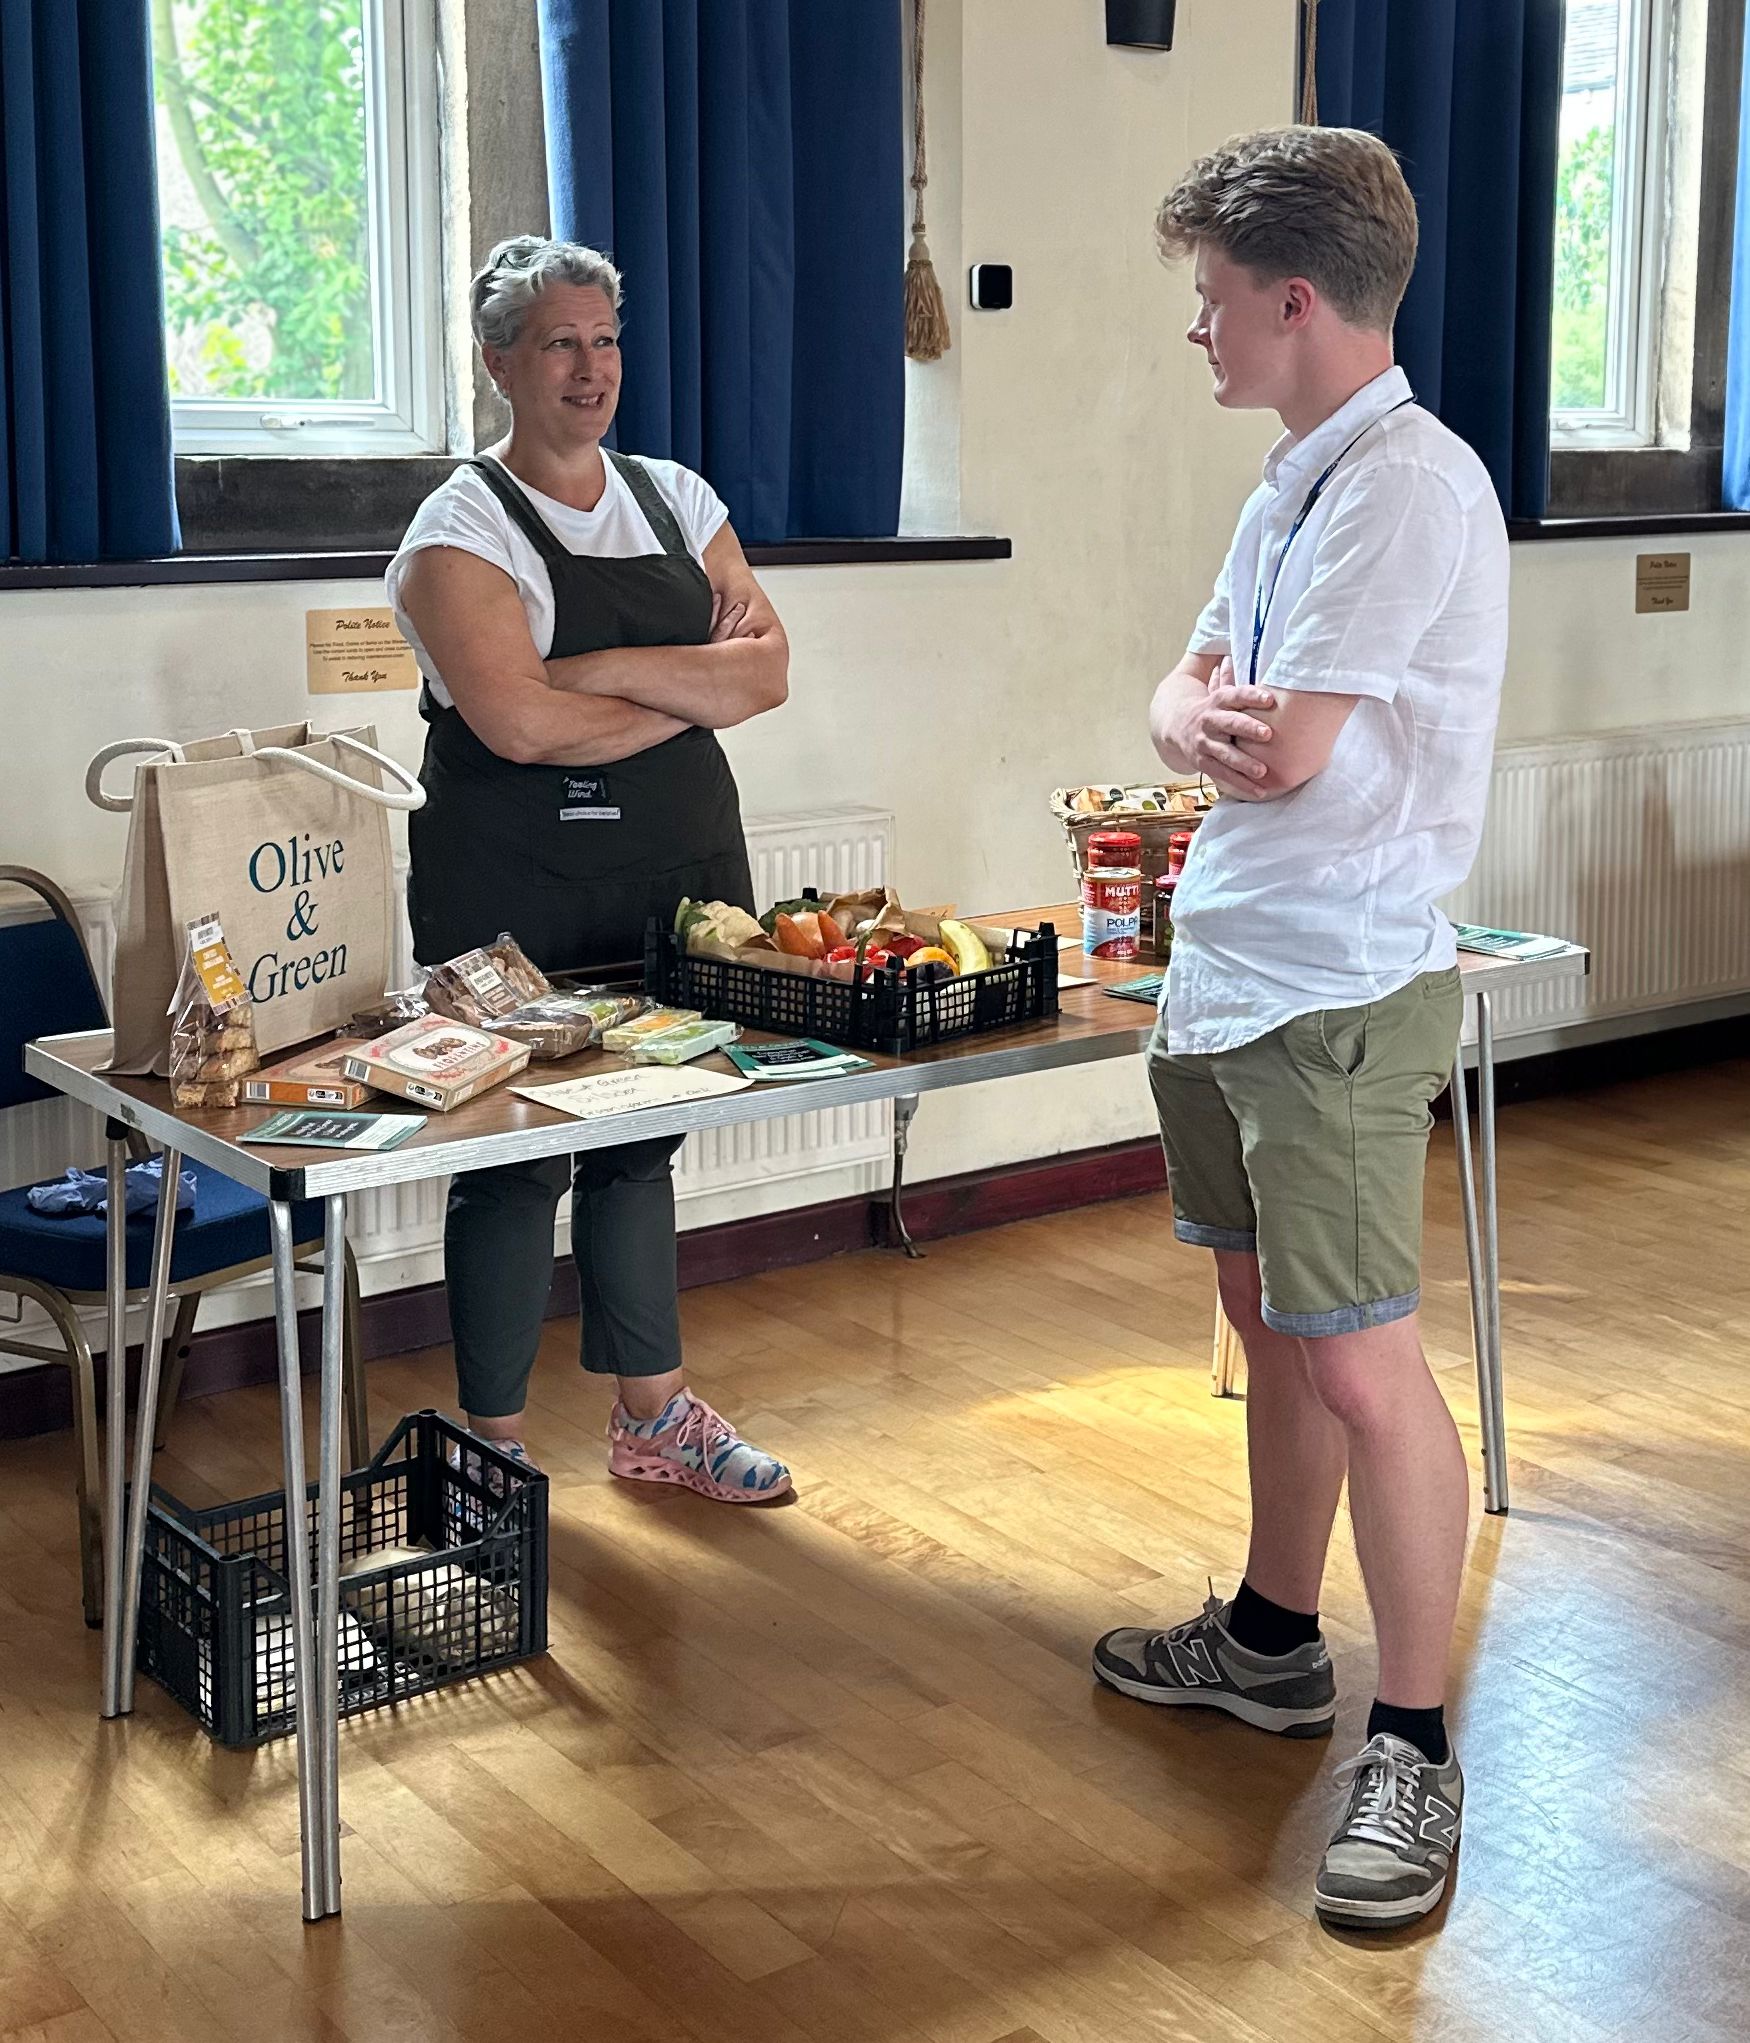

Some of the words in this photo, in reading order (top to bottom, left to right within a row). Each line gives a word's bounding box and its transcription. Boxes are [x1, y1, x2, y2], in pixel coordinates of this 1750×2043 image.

[342, 671, 368, 682] Thank
[371, 670, 387, 683] You
[249, 833, 345, 893] Olive
[286, 890, 319, 941] &
[1105, 885, 1139, 898] MUTTI
[248, 943, 347, 1003] Green
[1167, 1639, 1222, 1687] N
[1419, 1794, 1457, 1854] N
